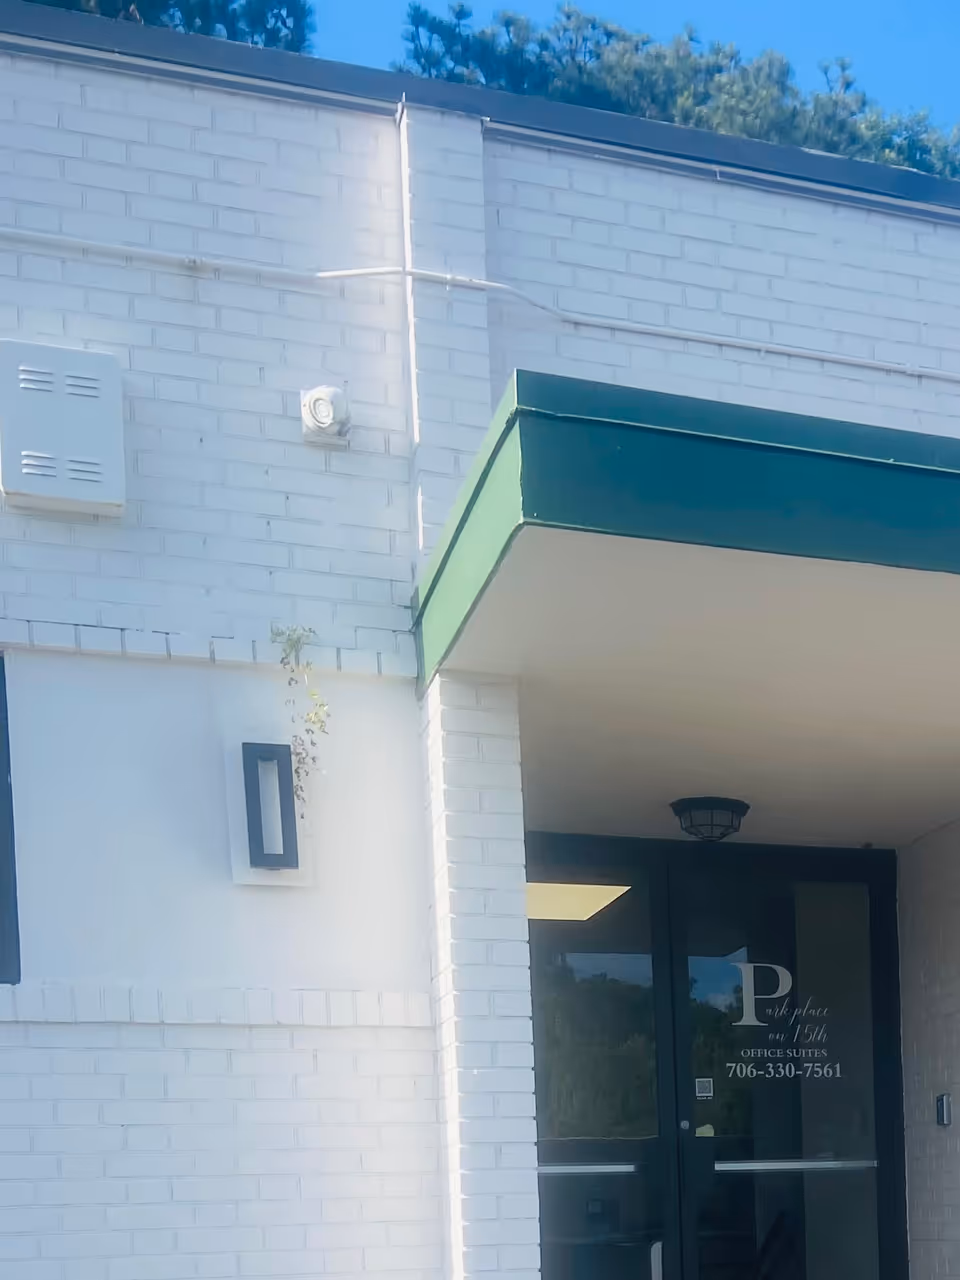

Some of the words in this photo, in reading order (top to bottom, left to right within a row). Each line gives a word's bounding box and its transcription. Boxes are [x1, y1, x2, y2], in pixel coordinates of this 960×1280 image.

[768, 1032, 788, 1042] on
[793, 1023, 829, 1044] 15th
[741, 1048, 784, 1058] OFFICE
[786, 1048, 828, 1058] SUITES
[726, 1062, 842, 1078] 706-330-7561
